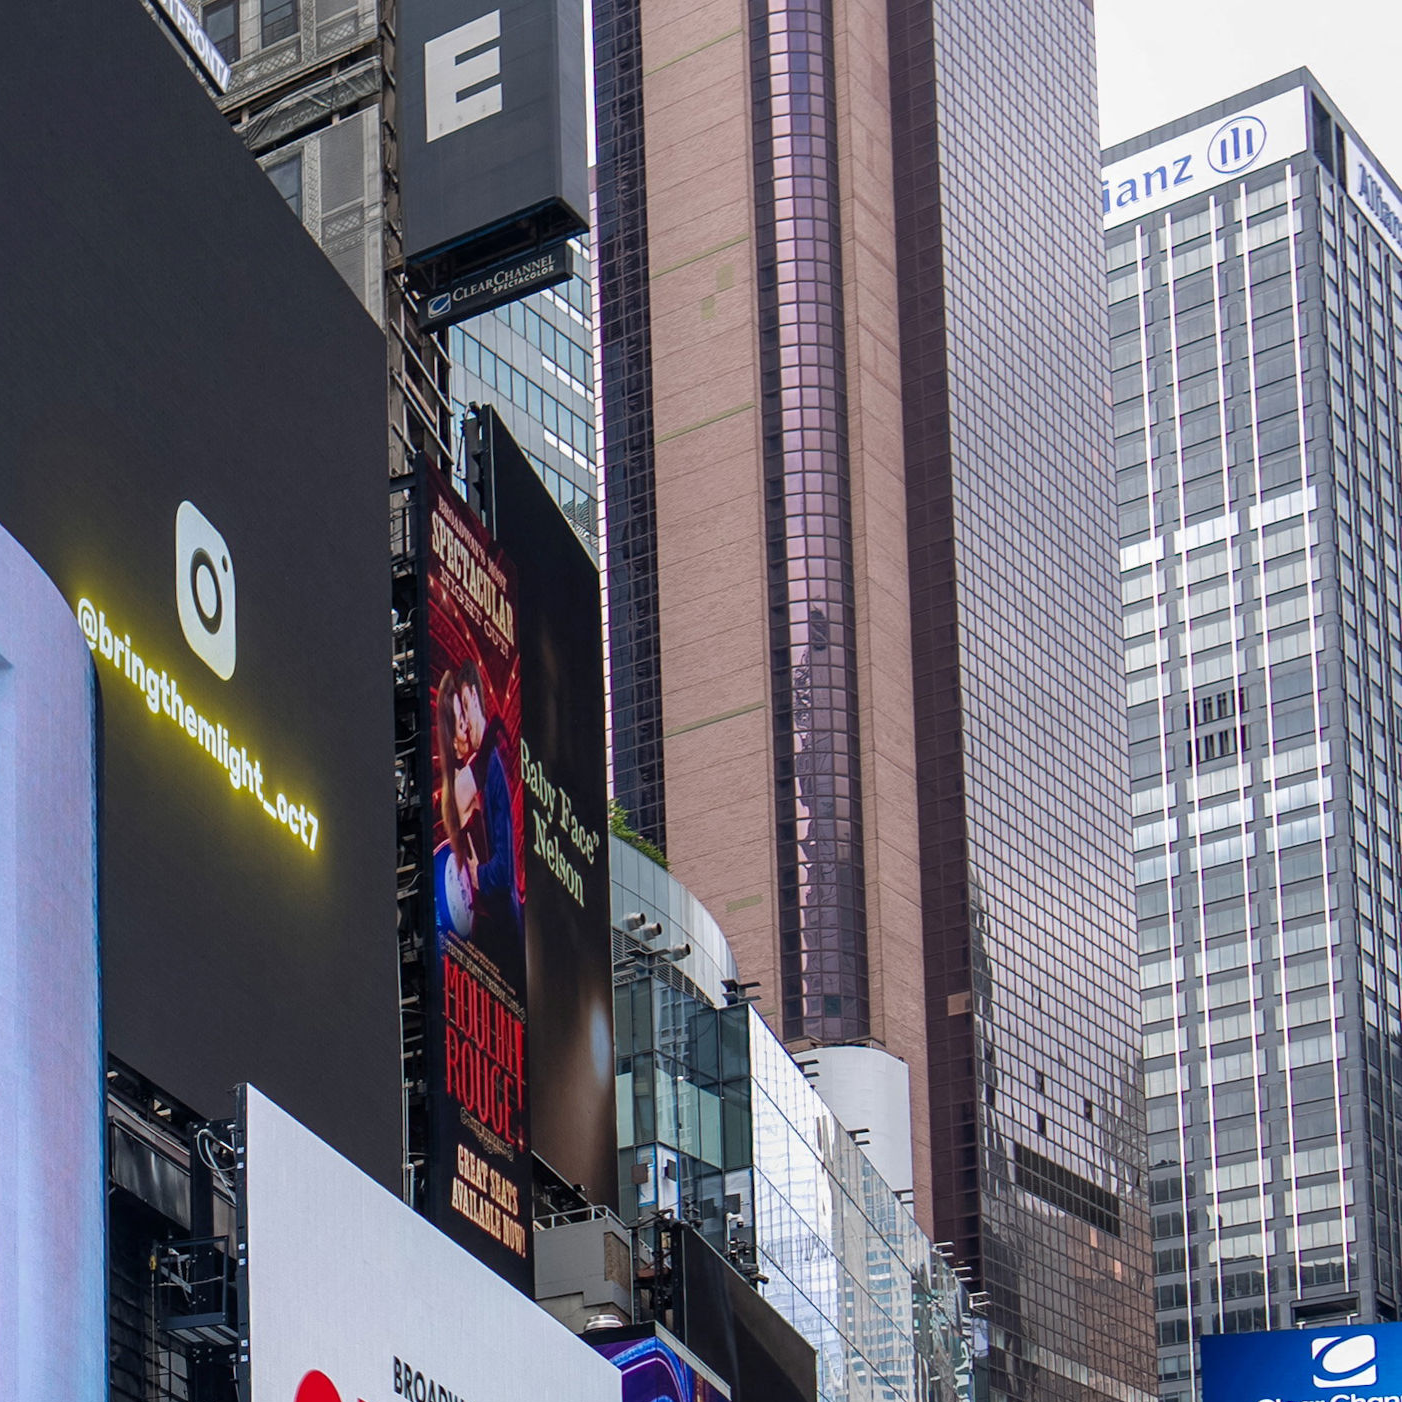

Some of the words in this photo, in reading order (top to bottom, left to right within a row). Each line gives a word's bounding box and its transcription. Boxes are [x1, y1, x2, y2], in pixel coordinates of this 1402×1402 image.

[492, 264, 555, 295] SPECTACOLOR
[437, 495, 488, 565] BROADWAY'S
[430, 510, 515, 647] SPECTACULAR
[438, 564, 484, 627] NIGHT
[77, 597, 320, 851] @bringthemlight_oct7
[531, 808, 585, 908] Nelson
[442, 953, 514, 1066] MOULIN
[451, 1176, 502, 1242] AVAILABLE
[502, 1212, 526, 1259] NOW!
[457, 1143, 489, 1188] GREAT
[489, 1166, 519, 1215] SEATS
